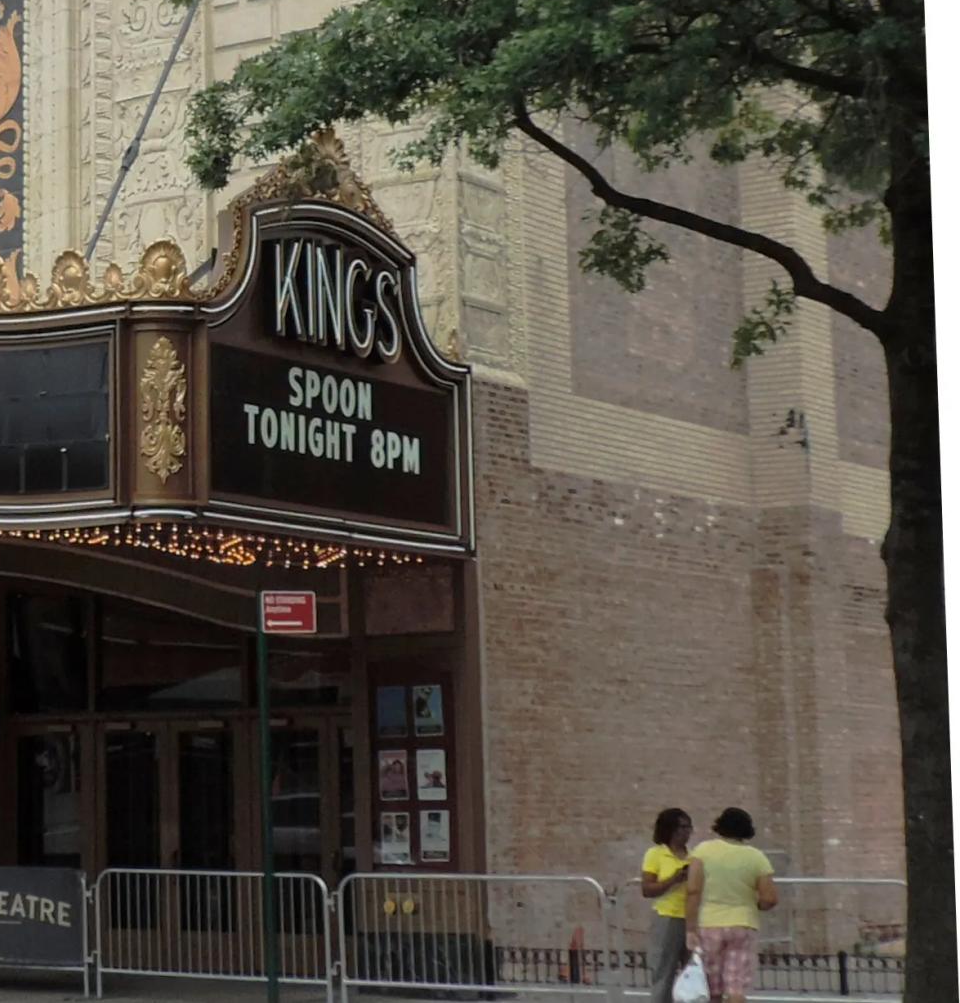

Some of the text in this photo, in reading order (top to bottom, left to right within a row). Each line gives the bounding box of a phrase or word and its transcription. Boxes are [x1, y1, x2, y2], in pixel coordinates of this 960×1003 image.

[274, 239, 401, 363] KINGS
[289, 367, 373, 421] SPOON
[244, 403, 420, 475] TONIGHT 8PM
